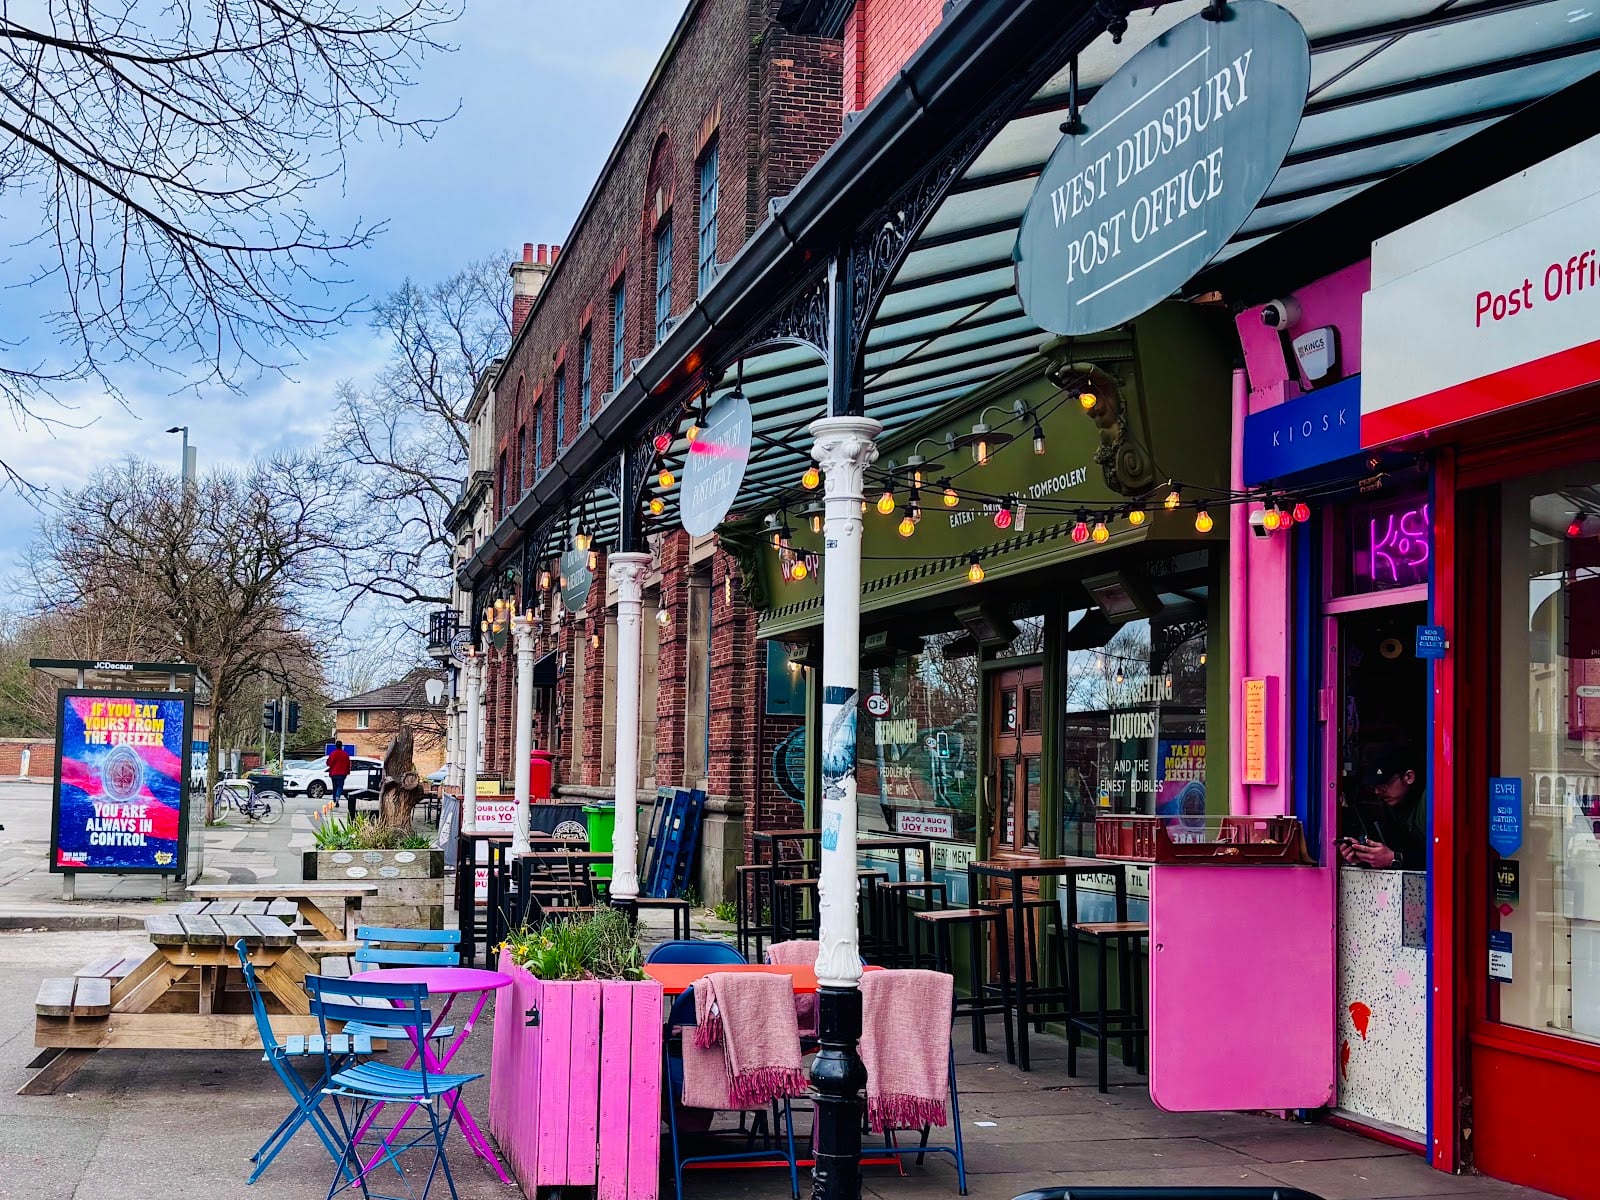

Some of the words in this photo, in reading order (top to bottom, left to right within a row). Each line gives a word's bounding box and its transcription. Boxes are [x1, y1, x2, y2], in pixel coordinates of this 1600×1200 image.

[1051, 150, 1112, 229] WEST
[1116, 47, 1254, 188] DIDSBURY
[1066, 208, 1126, 285] POST
[1130, 146, 1225, 246] OFFICE
[1475, 278, 1533, 328] Post
[1544, 249, 1600, 302] Offi
[1273, 408, 1346, 447] KIOSK
[949, 508, 975, 528] EATERY
[1028, 466, 1087, 500] TOMFOOLERY
[94, 662, 134, 670] JCDecaux
[91, 703, 106, 717] IF
[108, 703, 134, 718] YOU
[135, 704, 159, 718] EAT
[85, 717, 127, 731] YOURS
[128, 718, 165, 732] FROM
[874, 719, 917, 745] BEERMONGER
[1109, 711, 1155, 743] LIQUORS
[84, 730, 109, 744] THE
[111, 732, 165, 746] FREEZER
[879, 767, 903, 778] PEDDLER
[1114, 760, 1132, 774] AND
[1134, 759, 1149, 771] THE
[1100, 779, 1126, 792] FINEST
[1130, 779, 1164, 793] EDIBLES
[94, 803, 121, 818] YOU
[123, 804, 147, 819] ARE
[498, 813, 513, 822] YO
[86, 817, 136, 832] ALWAYS
[139, 819, 153, 833] IN
[90, 832, 148, 847] CONTROL
[1131, 874, 1143, 887] TIL
[1497, 871, 1515, 885] VIP
